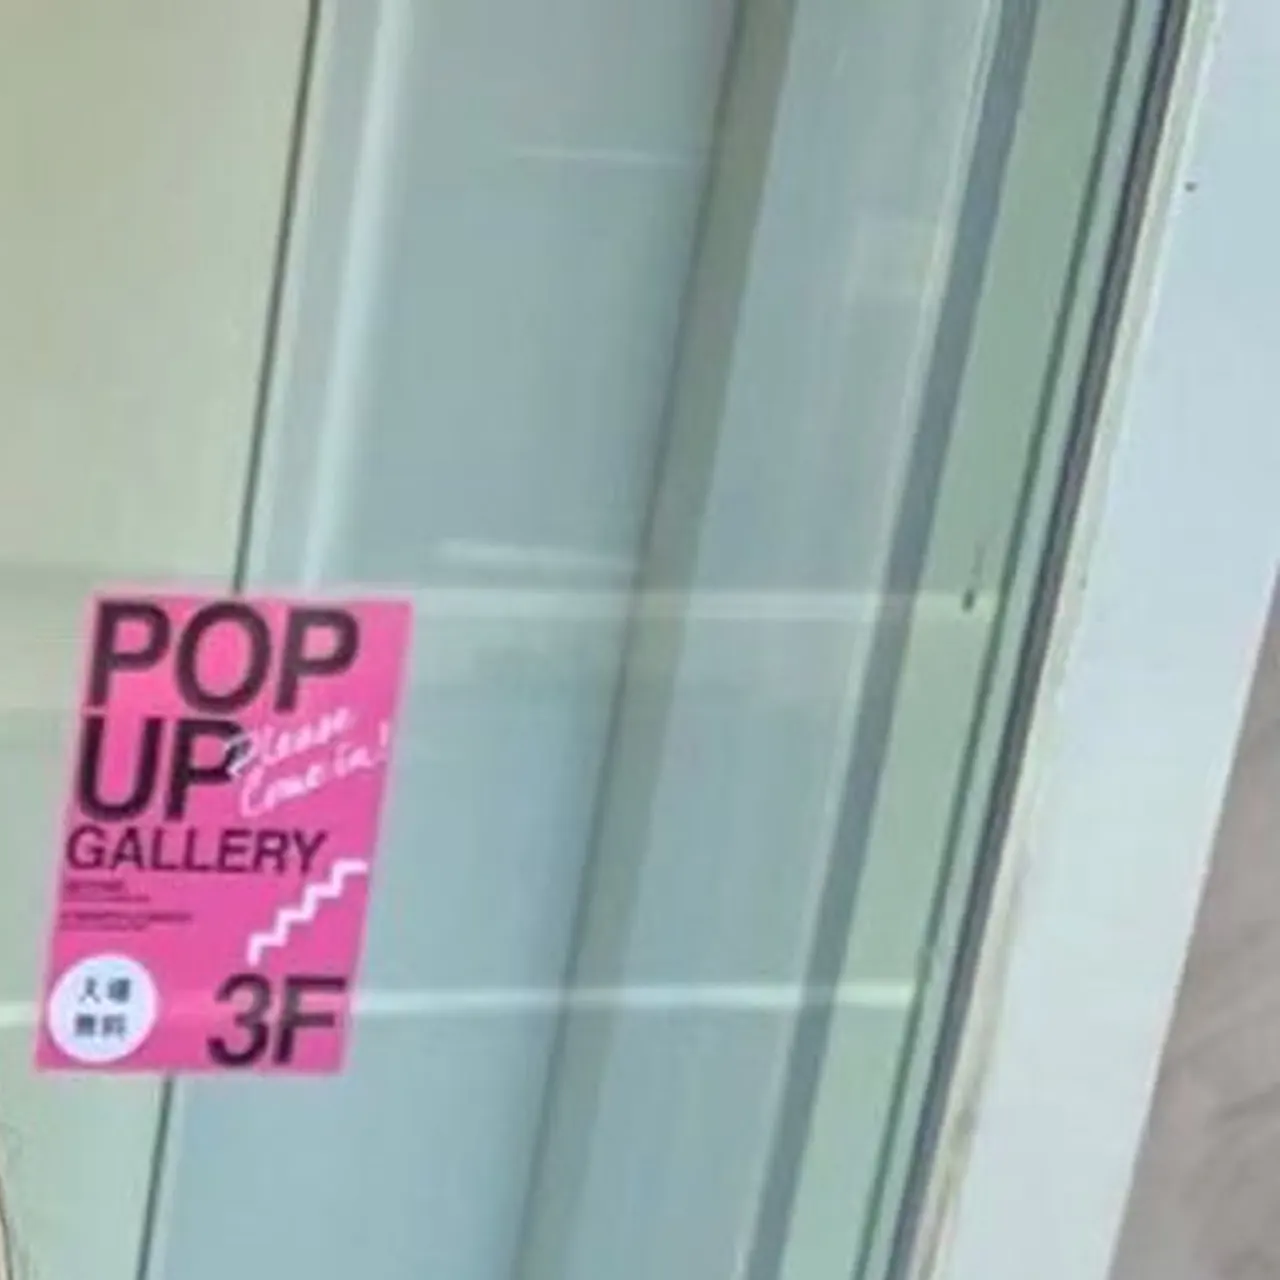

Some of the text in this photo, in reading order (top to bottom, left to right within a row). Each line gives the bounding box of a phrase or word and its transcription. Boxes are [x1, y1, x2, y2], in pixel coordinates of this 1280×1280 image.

[87, 600, 360, 713] POP
[79, 715, 253, 822] UP
[66, 826, 328, 874] GALLERY
[207, 972, 347, 1069] 3F
